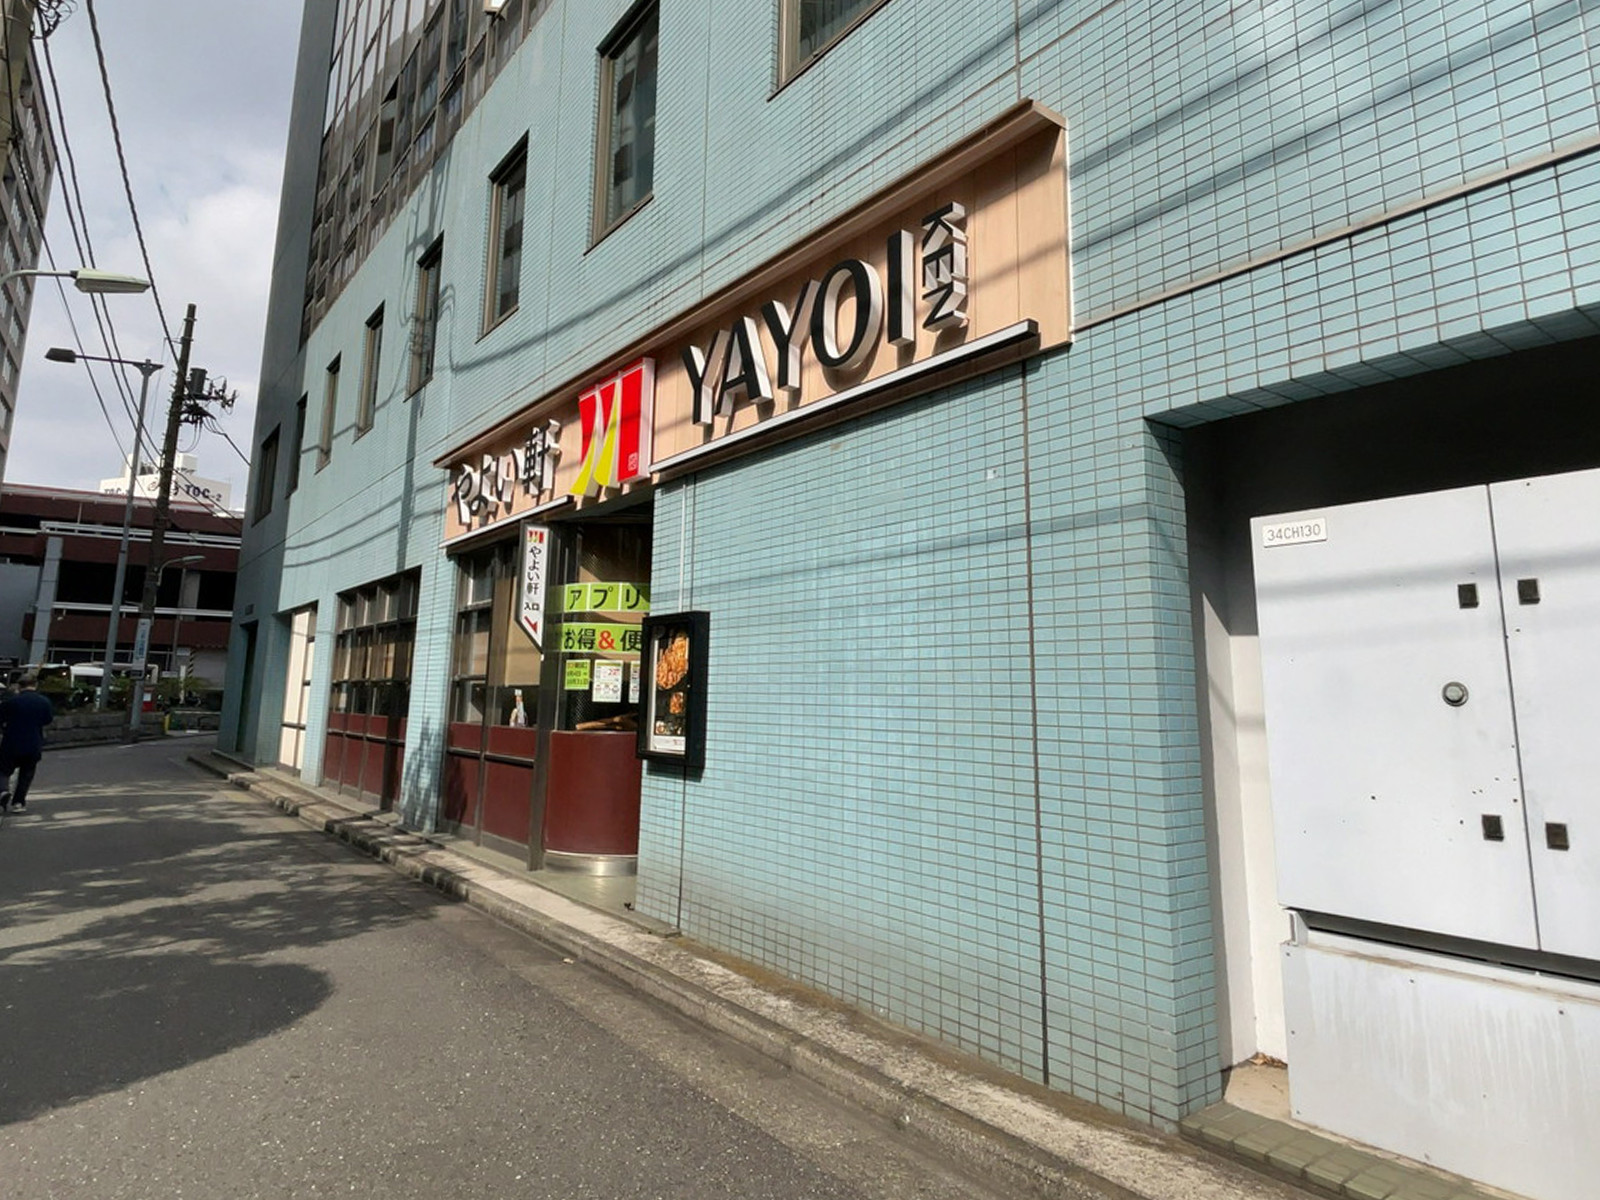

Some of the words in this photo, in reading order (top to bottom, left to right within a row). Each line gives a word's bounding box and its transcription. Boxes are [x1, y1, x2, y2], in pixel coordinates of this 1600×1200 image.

[922, 201, 967, 332] KEN
[681, 229, 915, 427] YAYOI
[1267, 523, 1321, 541] 34CH130
[527, 545, 542, 595] やよい軒
[524, 602, 540, 611] 入口
[569, 585, 641, 610] アプリ
